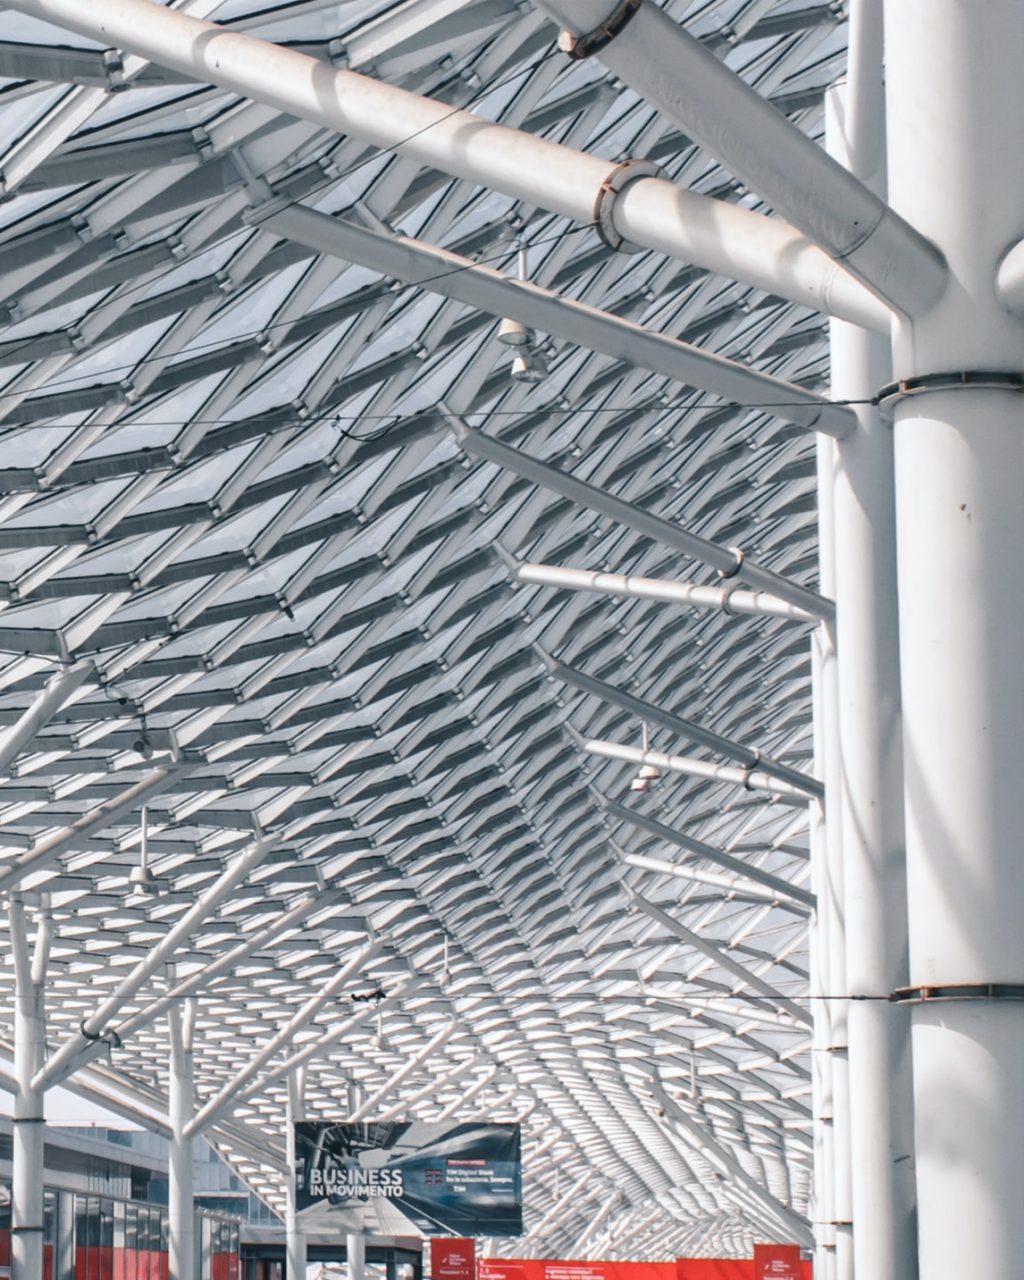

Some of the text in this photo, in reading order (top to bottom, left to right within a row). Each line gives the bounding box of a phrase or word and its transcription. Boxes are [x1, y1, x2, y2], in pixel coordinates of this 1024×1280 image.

[310, 1168, 403, 1185] BUSINESS
[310, 1185, 404, 1197] IN MOVIMENTO
